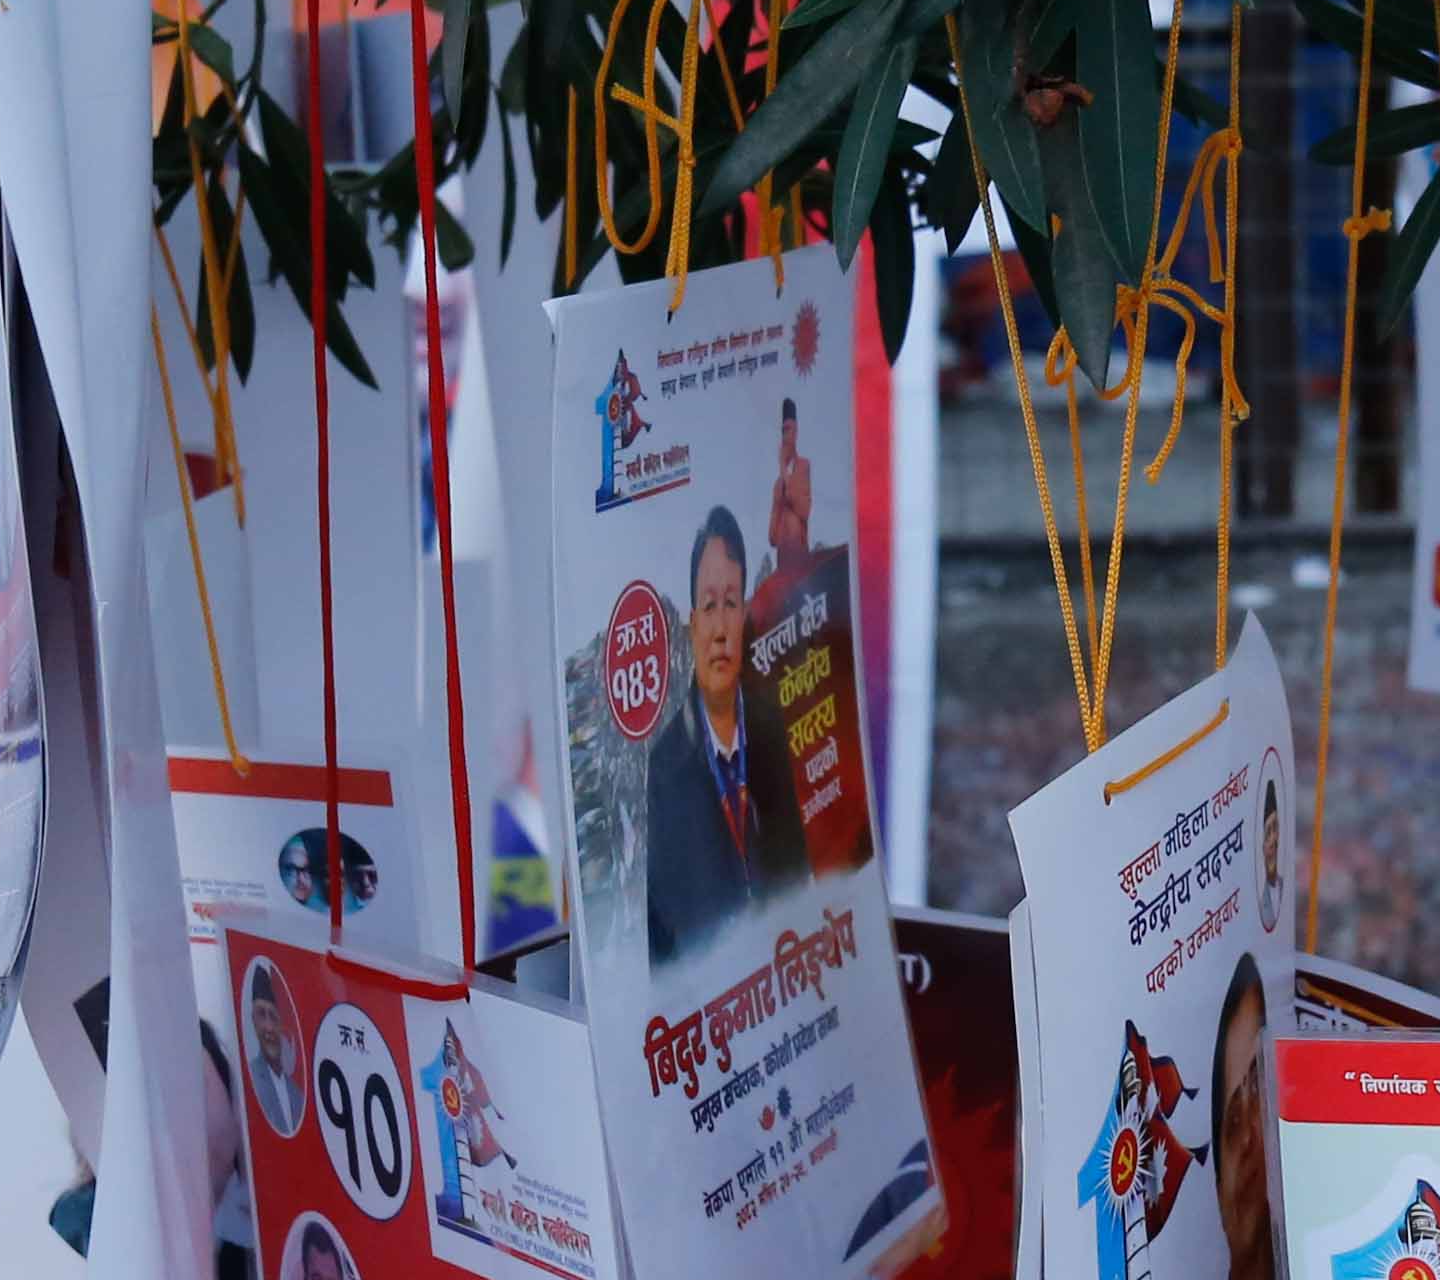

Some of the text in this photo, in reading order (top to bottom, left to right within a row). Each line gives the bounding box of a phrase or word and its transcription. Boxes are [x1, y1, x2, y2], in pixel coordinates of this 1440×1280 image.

[612, 654, 660, 713] १४३
[750, 615, 797, 677] खुल्ला
[778, 645, 832, 708] केन्द्रीय
[788, 693, 836, 758] सदस्य
[1118, 840, 1162, 901] खुल्ला
[1163, 799, 1210, 857] महिला
[1128, 819, 1245, 947] केन्द्रीय सदस्य
[1146, 888, 1241, 994] पदको उम्मेदवार
[643, 1015, 707, 1100] बिदुर
[704, 962, 777, 1073] कुमार
[318, 1058, 403, 1198] १०
[689, 1088, 723, 1134] प्रमुख
[702, 1178, 735, 1220] नेकपा
[736, 1149, 769, 1199] एमाले
[769, 1139, 785, 1167] ११
